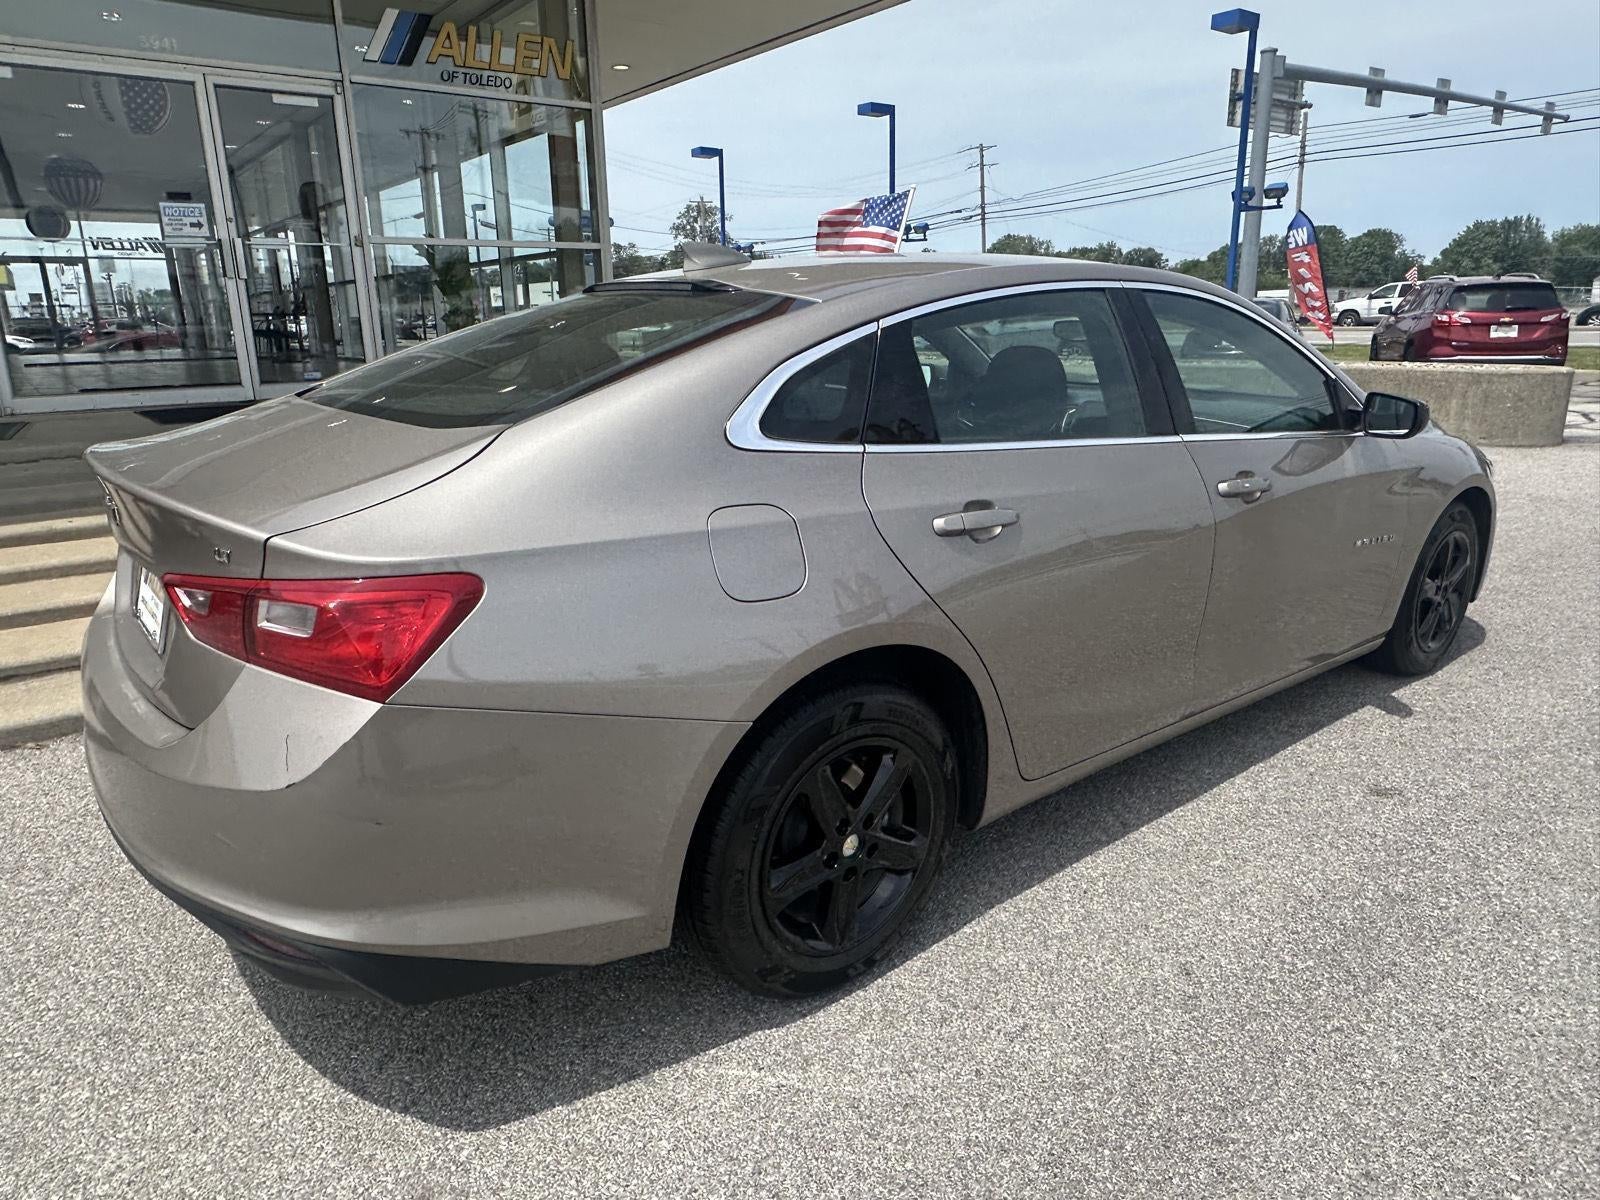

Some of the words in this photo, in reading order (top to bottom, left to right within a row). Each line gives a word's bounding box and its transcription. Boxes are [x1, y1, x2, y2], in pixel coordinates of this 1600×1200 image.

[426, 21, 575, 80] ALLEN
[440, 68, 459, 84] OF
[463, 72, 513, 89] TOLEDO
[164, 206, 202, 217] NOTICE
